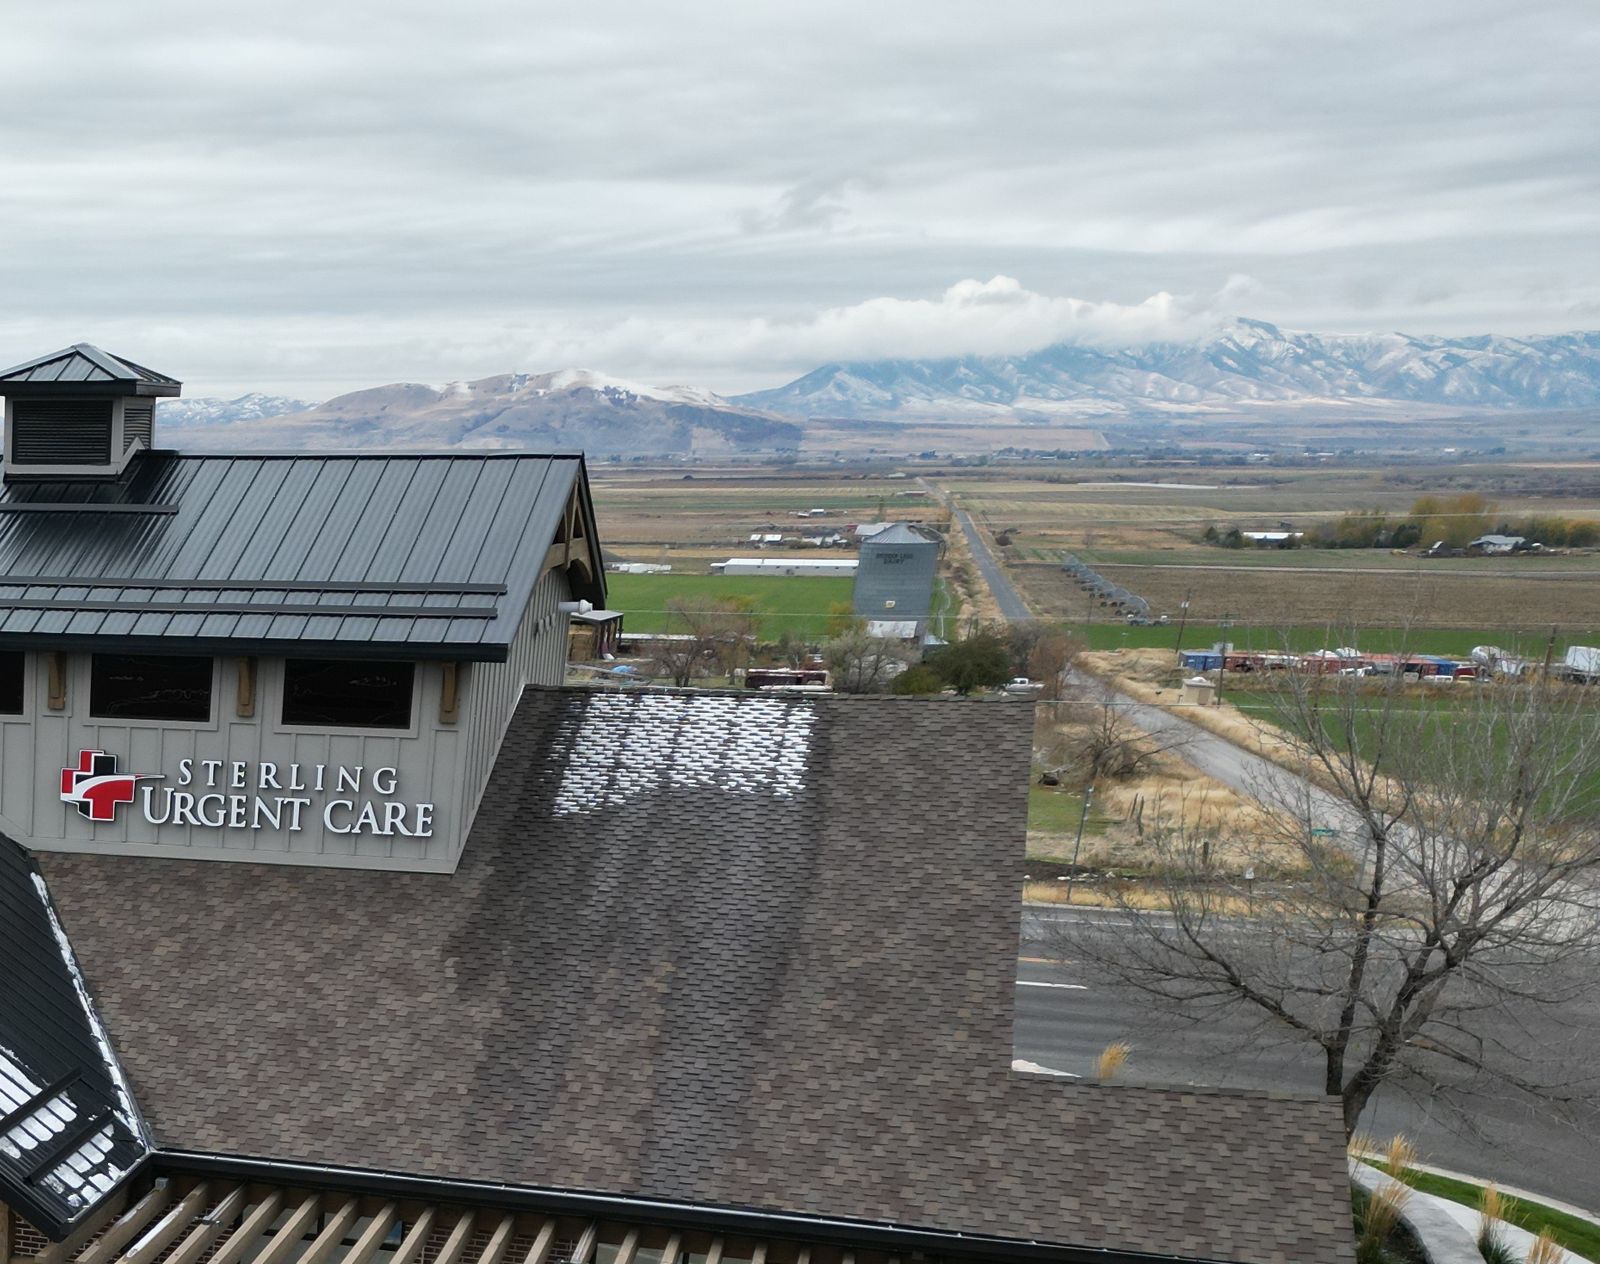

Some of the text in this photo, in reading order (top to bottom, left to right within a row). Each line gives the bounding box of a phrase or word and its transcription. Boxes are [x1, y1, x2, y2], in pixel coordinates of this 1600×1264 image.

[178, 759, 398, 794] STERLING
[142, 786, 434, 837] URGENT CARE
